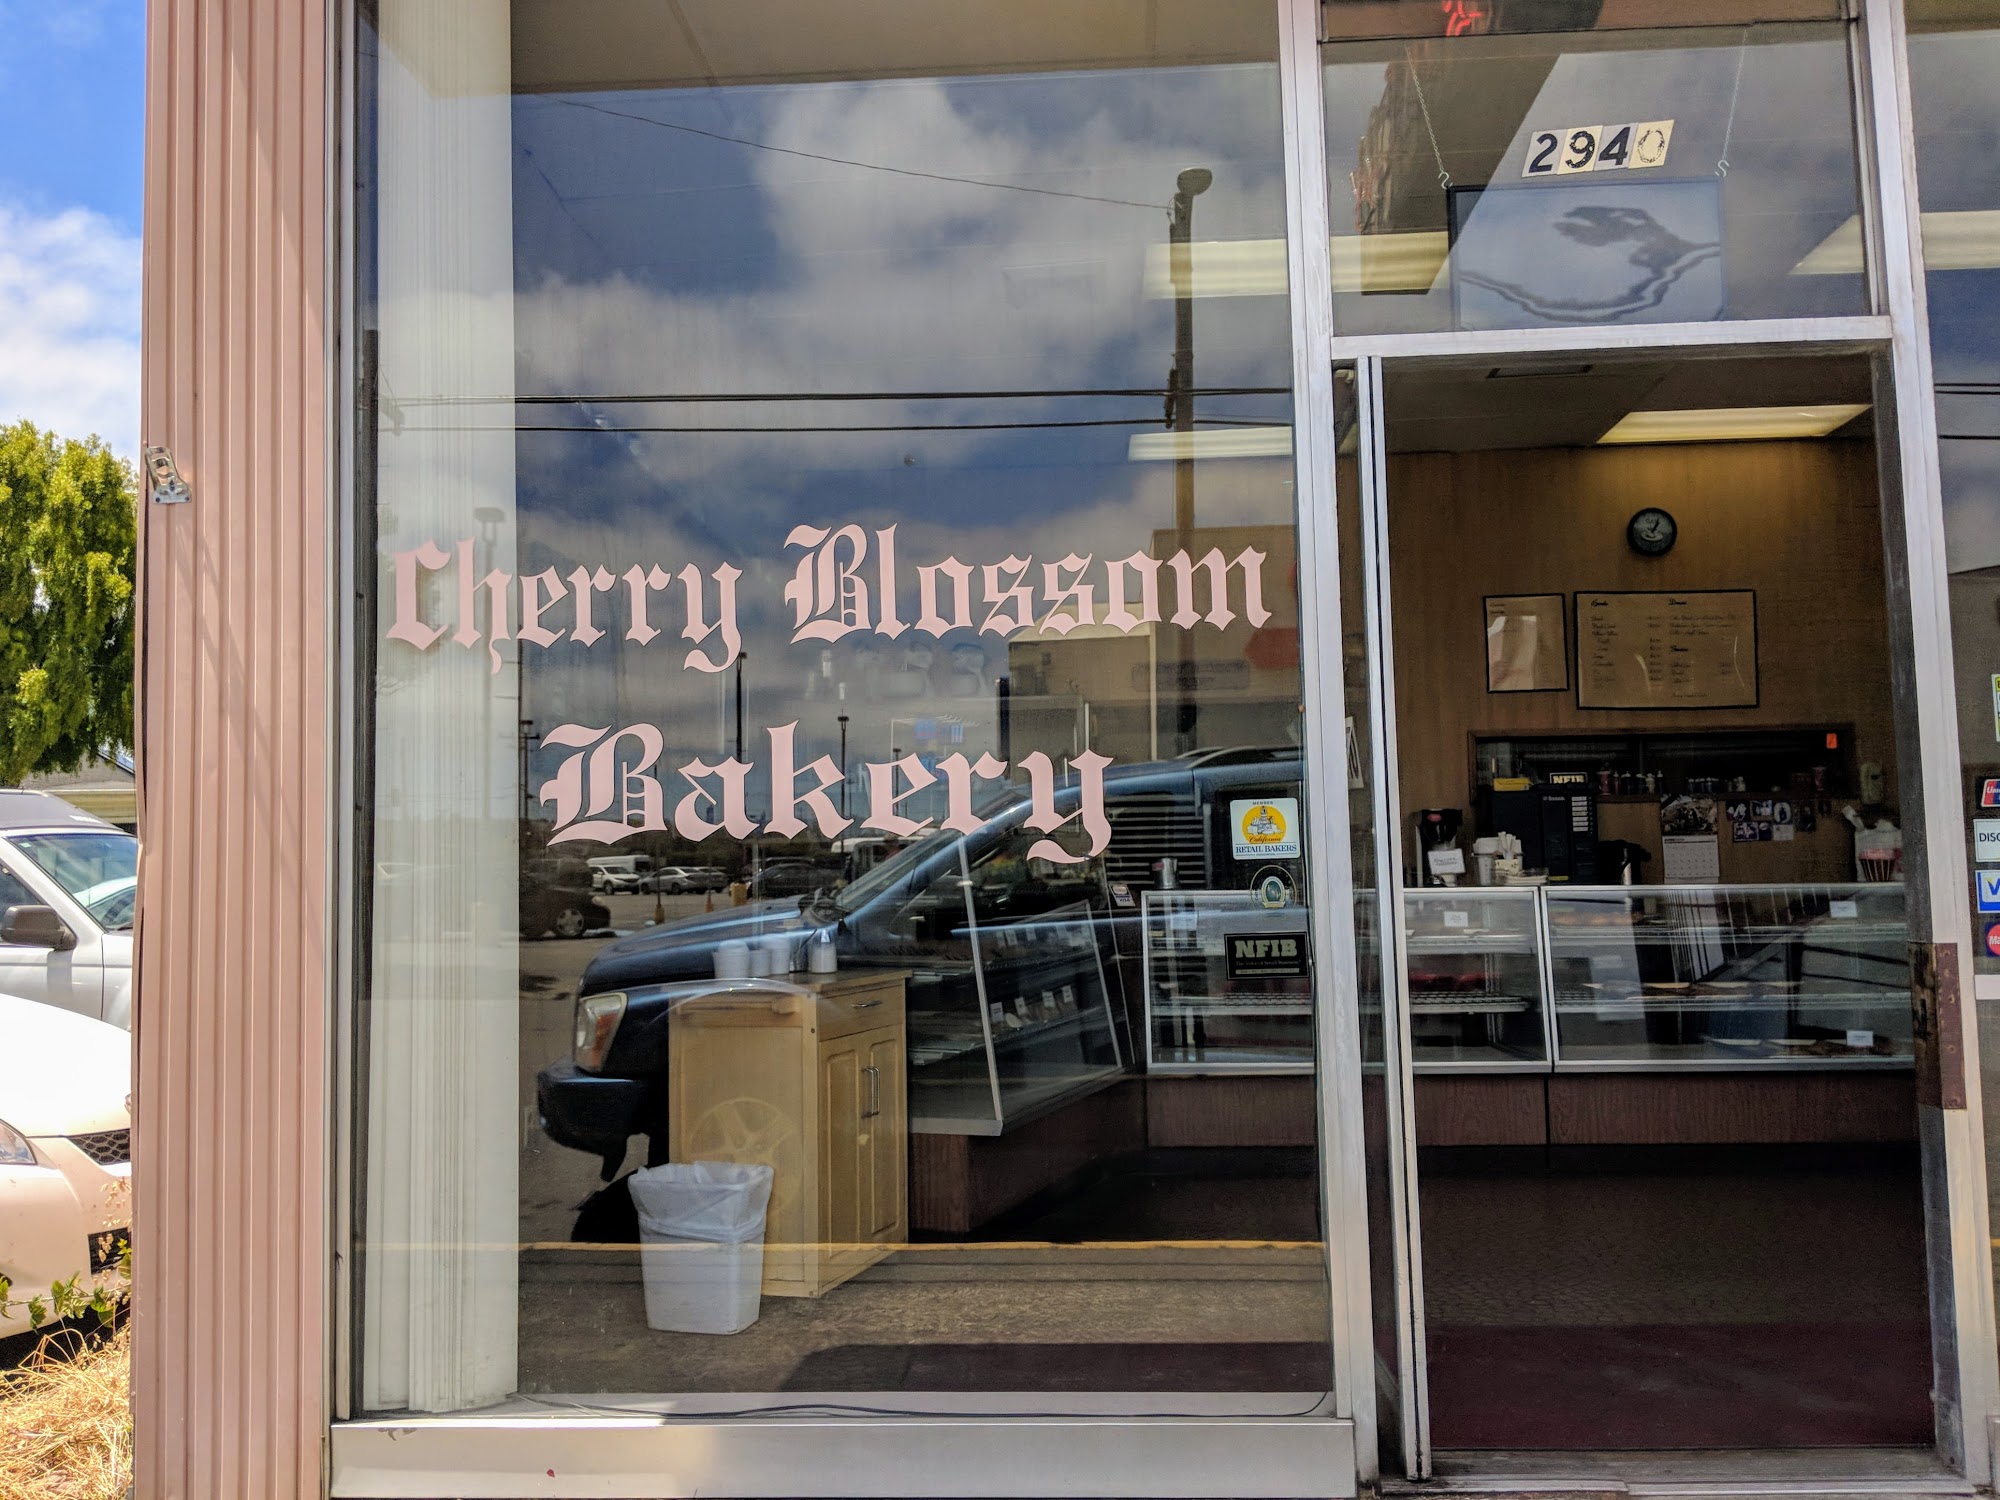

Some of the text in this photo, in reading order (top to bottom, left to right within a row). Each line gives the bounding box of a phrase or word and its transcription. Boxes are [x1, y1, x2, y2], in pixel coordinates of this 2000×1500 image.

[1528, 126, 1665, 173] 2940
[386, 523, 1273, 676] Cherry Blossom
[539, 720, 1114, 865] Bakery
[1235, 844, 1297, 854] RETAIL BAKERS
[1249, 835, 1282, 844] California
[1235, 939, 1297, 958] NFIB
